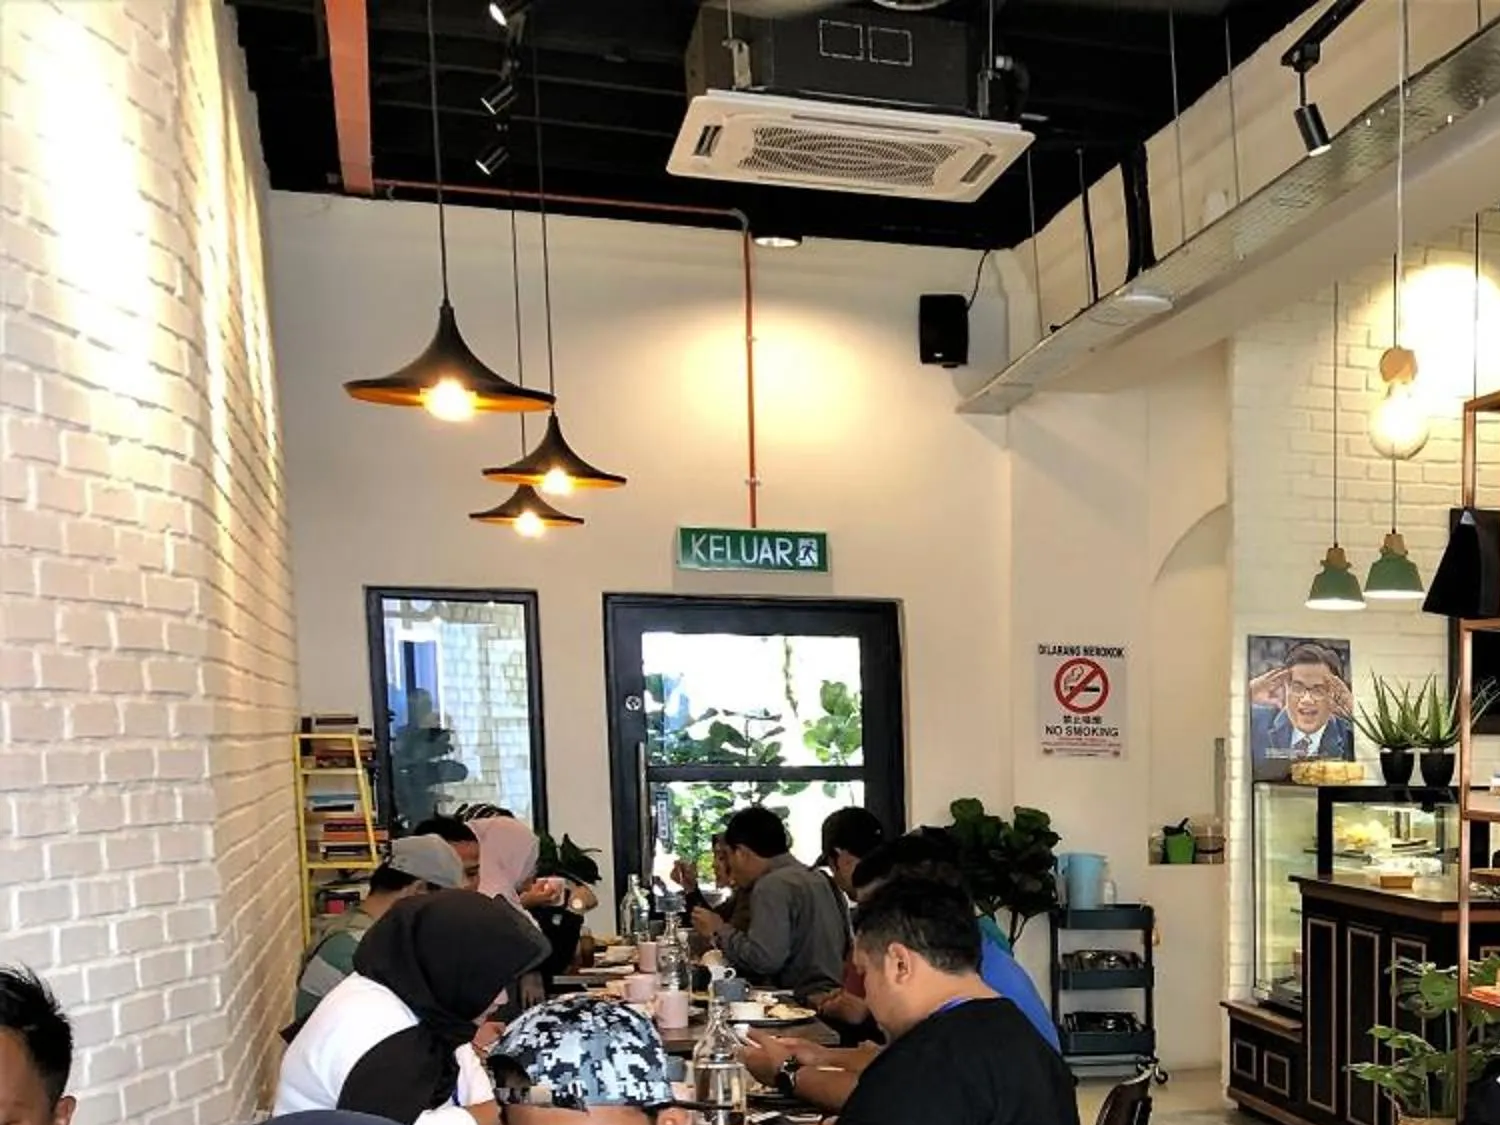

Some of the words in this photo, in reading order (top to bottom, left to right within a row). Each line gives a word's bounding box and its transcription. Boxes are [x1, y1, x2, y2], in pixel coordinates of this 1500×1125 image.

[691, 533, 794, 567] KELUAR
[1038, 644, 1081, 657] DILARANG
[1083, 646, 1125, 659] MEROKOK
[1045, 725, 1062, 736] NO
[1065, 726, 1119, 737] SMOKING
